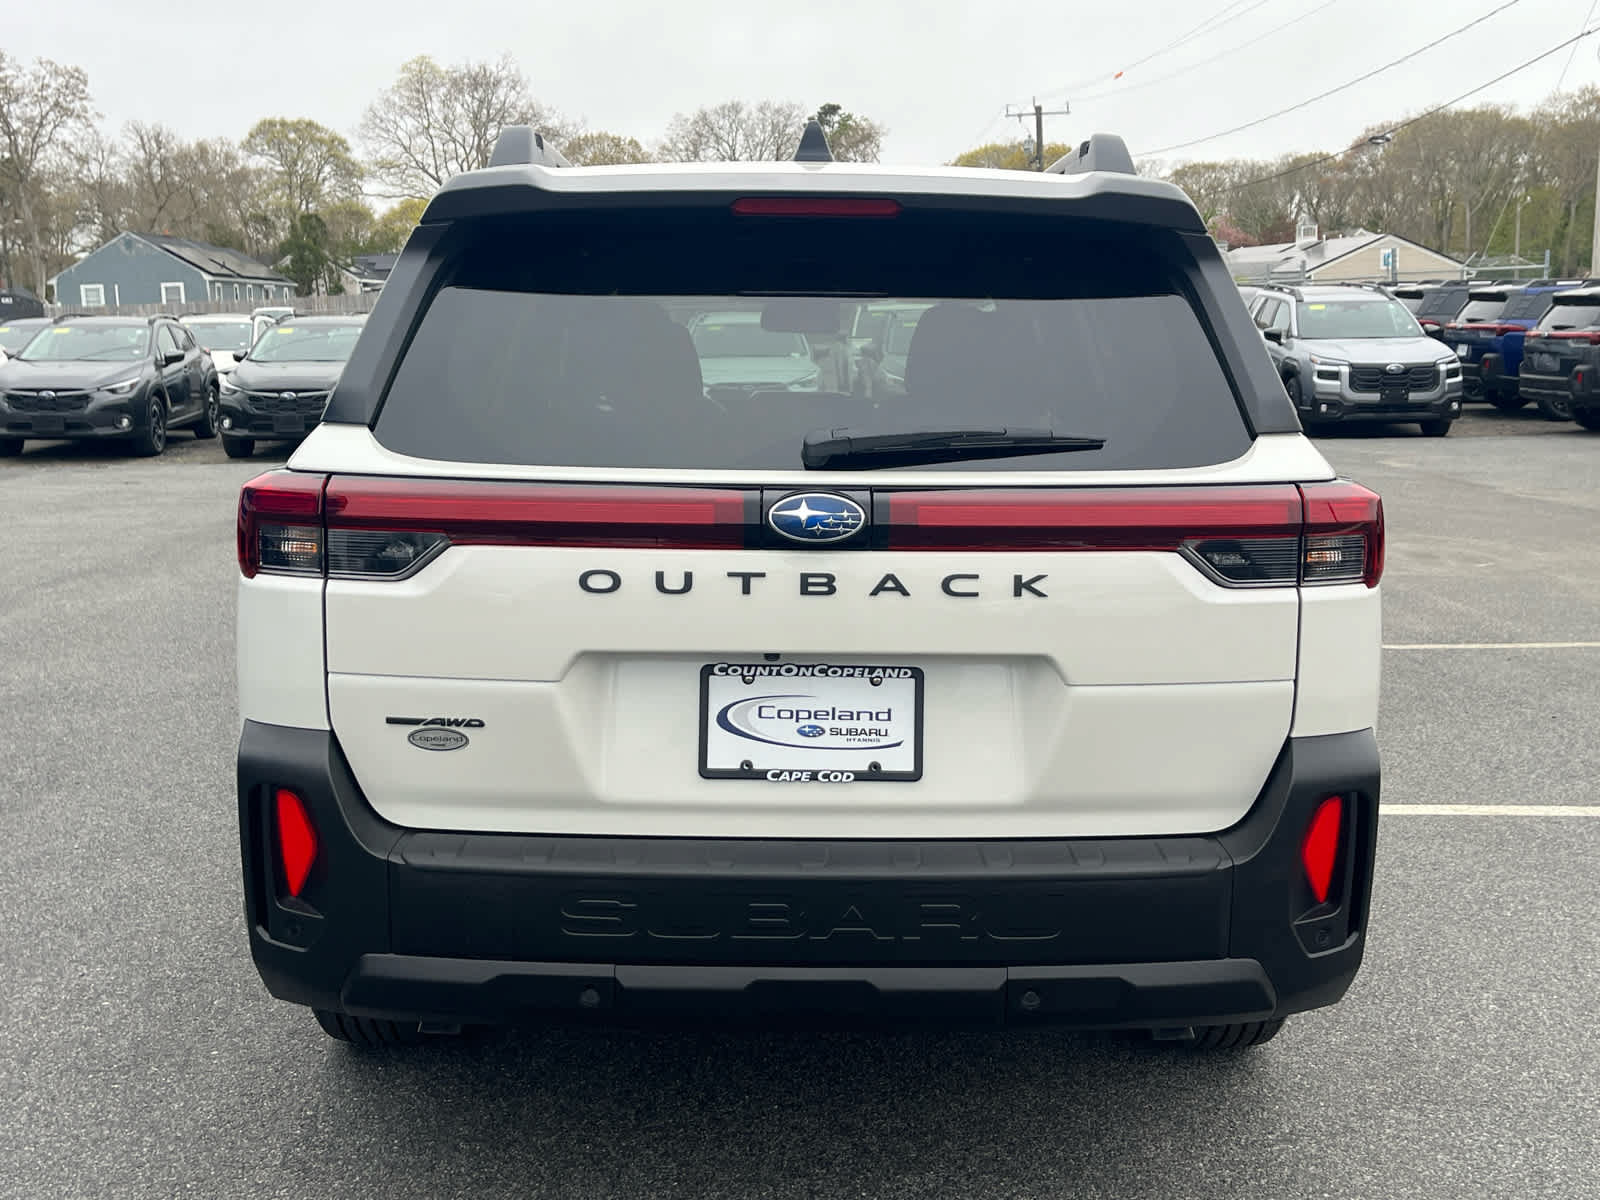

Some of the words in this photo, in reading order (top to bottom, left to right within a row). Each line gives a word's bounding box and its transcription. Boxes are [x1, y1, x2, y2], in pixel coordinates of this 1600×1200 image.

[579, 570, 1048, 598] OUTBACK
[758, 705, 892, 722] Copeland
[423, 718, 485, 728] AWD
[412, 734, 463, 745] Copeland
[829, 728, 888, 737] SUBARU
[767, 769, 811, 782] CAPE
[818, 770, 855, 783] COD
[561, 899, 1062, 941] SUBARU
